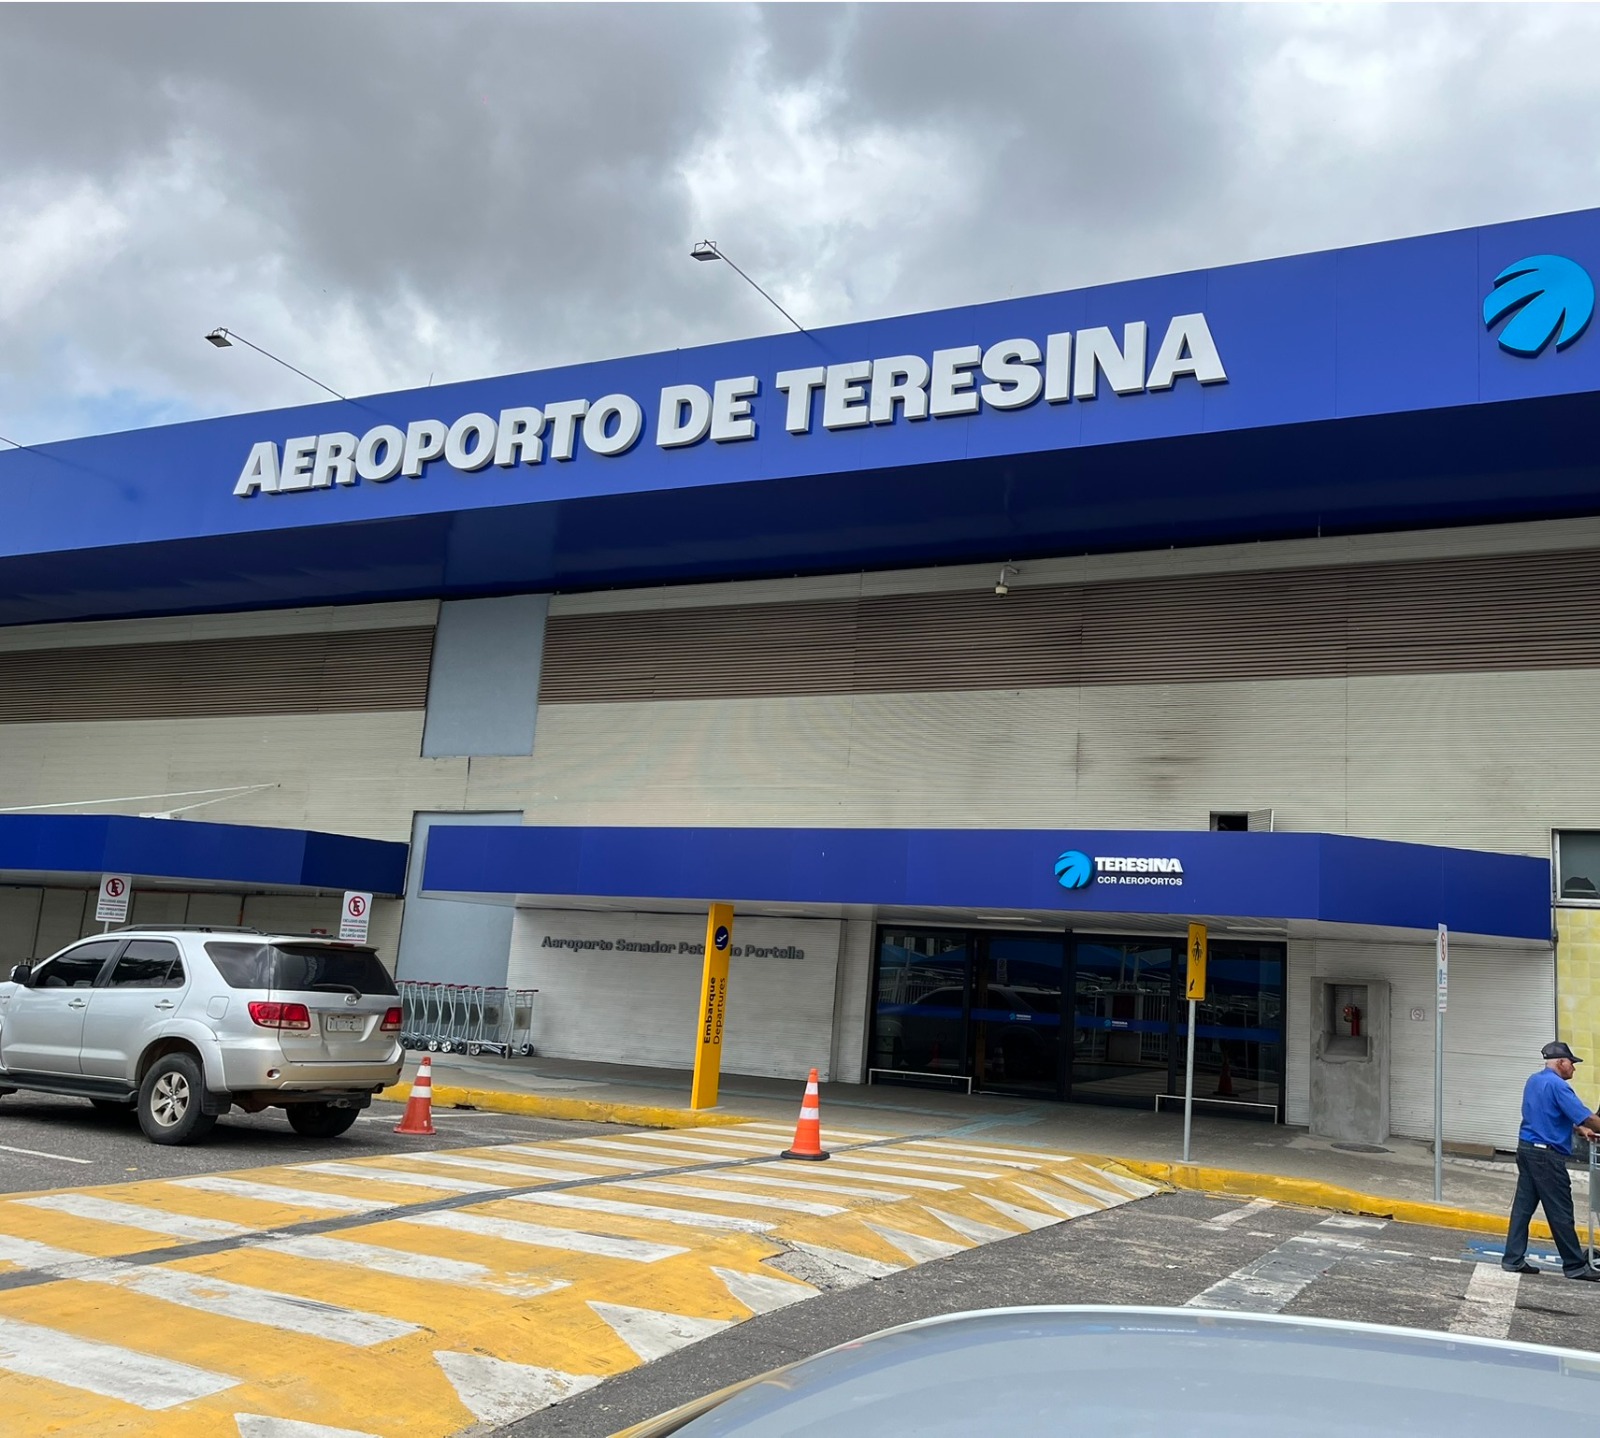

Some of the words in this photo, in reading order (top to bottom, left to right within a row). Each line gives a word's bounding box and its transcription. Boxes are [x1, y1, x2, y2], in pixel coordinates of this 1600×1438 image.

[233, 393, 644, 497] AEROPORTO
[656, 374, 759, 448] DE
[775, 312, 1228, 434] TERESINA
[1094, 856, 1184, 873] TERESINA
[1097, 876, 1117, 884] CCR
[1119, 876, 1183, 886] AEROPORTOS
[541, 935, 614, 953] Aeroporto
[615, 938, 677, 954] Senador
[744, 944, 805, 960] Portella
[703, 977, 716, 1044] Embarque
[712, 977, 726, 1045] Departures
